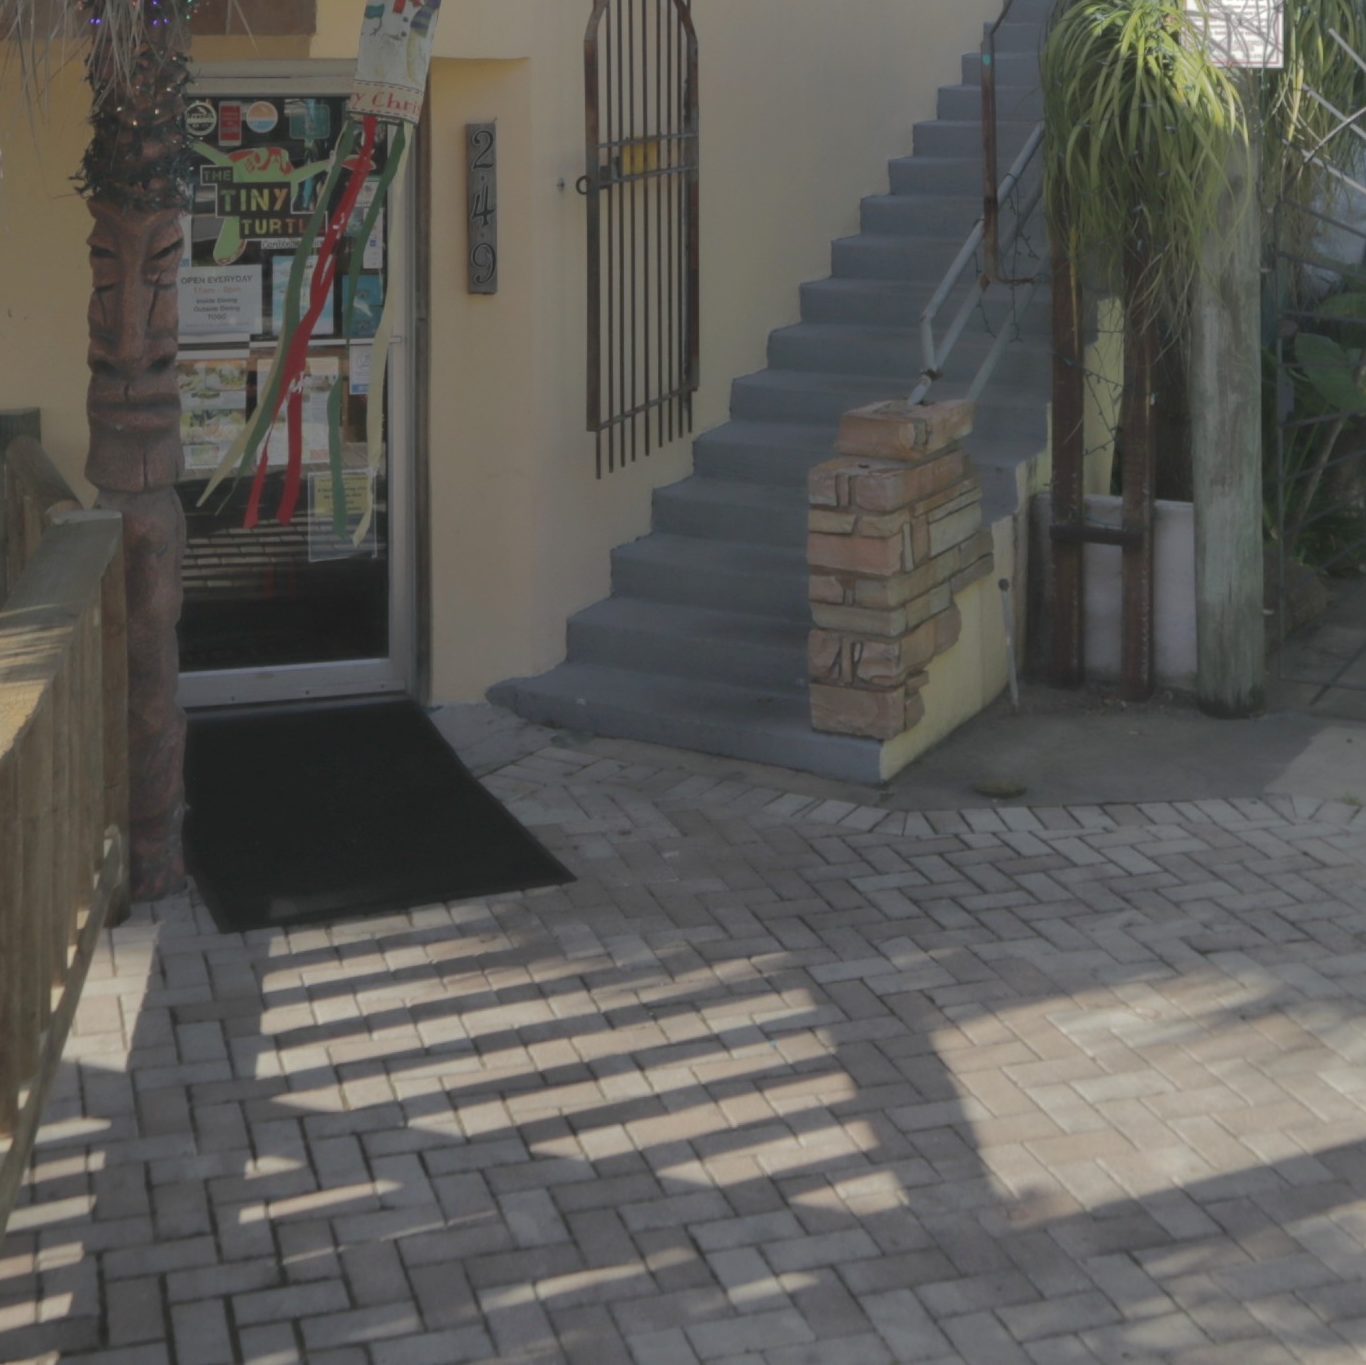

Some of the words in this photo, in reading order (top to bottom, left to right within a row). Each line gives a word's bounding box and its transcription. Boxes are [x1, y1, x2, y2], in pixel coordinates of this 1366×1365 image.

[202, 169, 232, 182] THE
[220, 187, 289, 213] TINY
[241, 218, 325, 235] TURTL
[180, 276, 206, 284] OPEN
[207, 275, 253, 284] EVERYDAY
